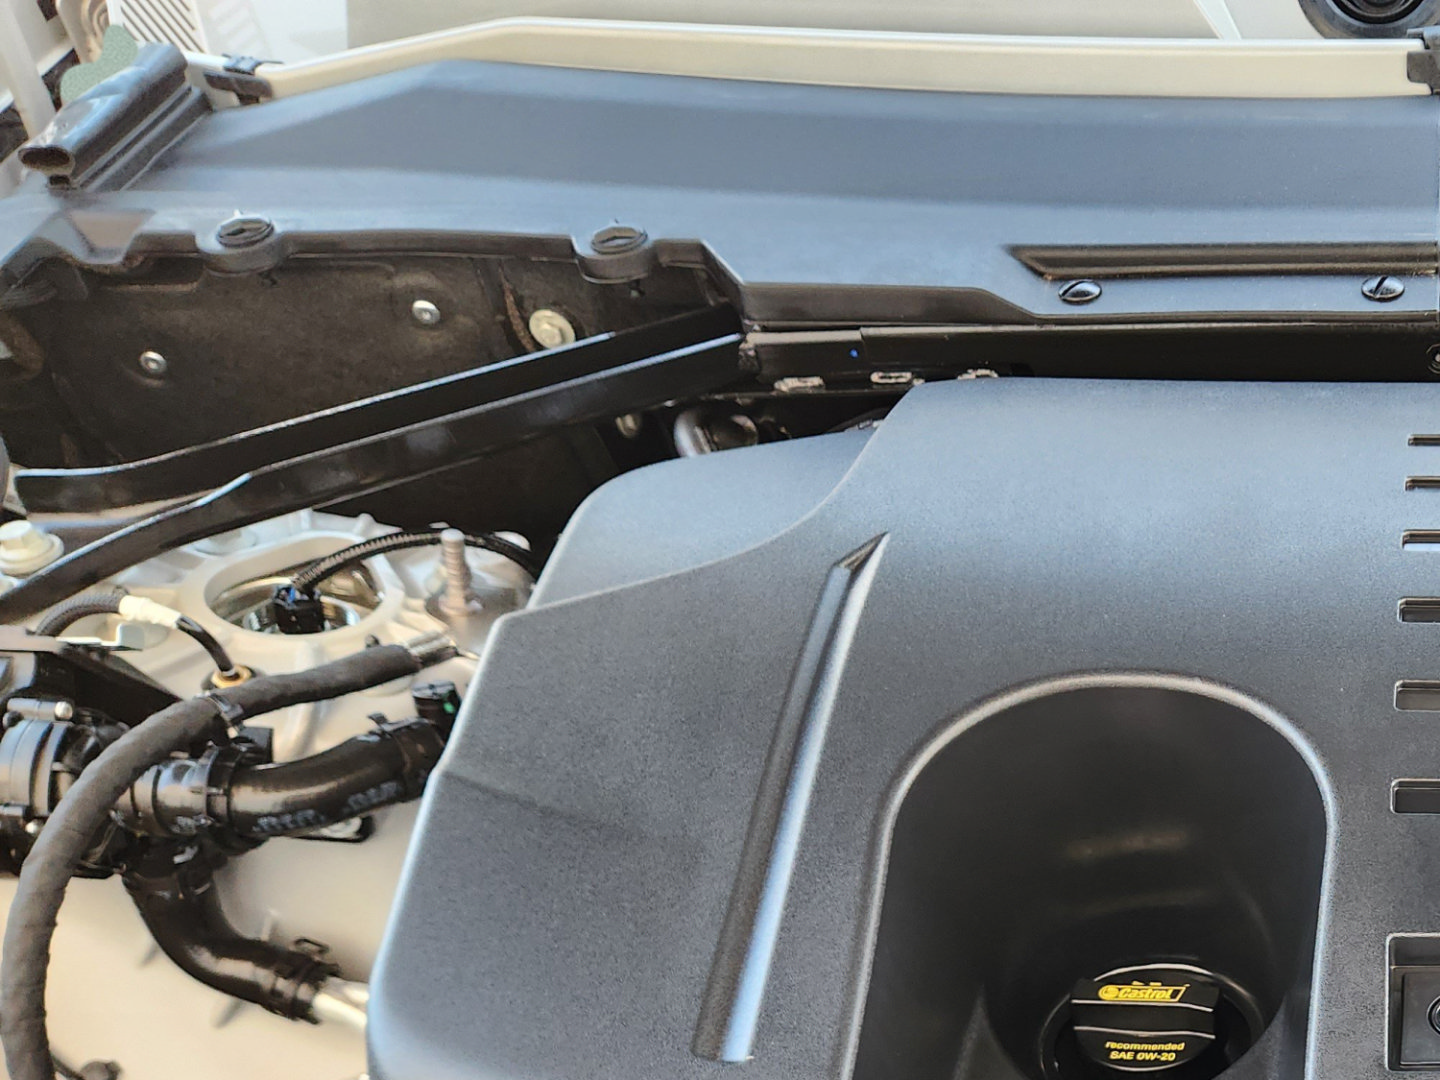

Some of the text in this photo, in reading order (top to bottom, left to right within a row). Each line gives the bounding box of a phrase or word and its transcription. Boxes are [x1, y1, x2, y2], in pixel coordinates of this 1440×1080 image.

[1118, 986, 1173, 1000] Castrol
[1105, 1041, 1185, 1051] recommended
[1109, 1050, 1176, 1062] SAE 0W-20
